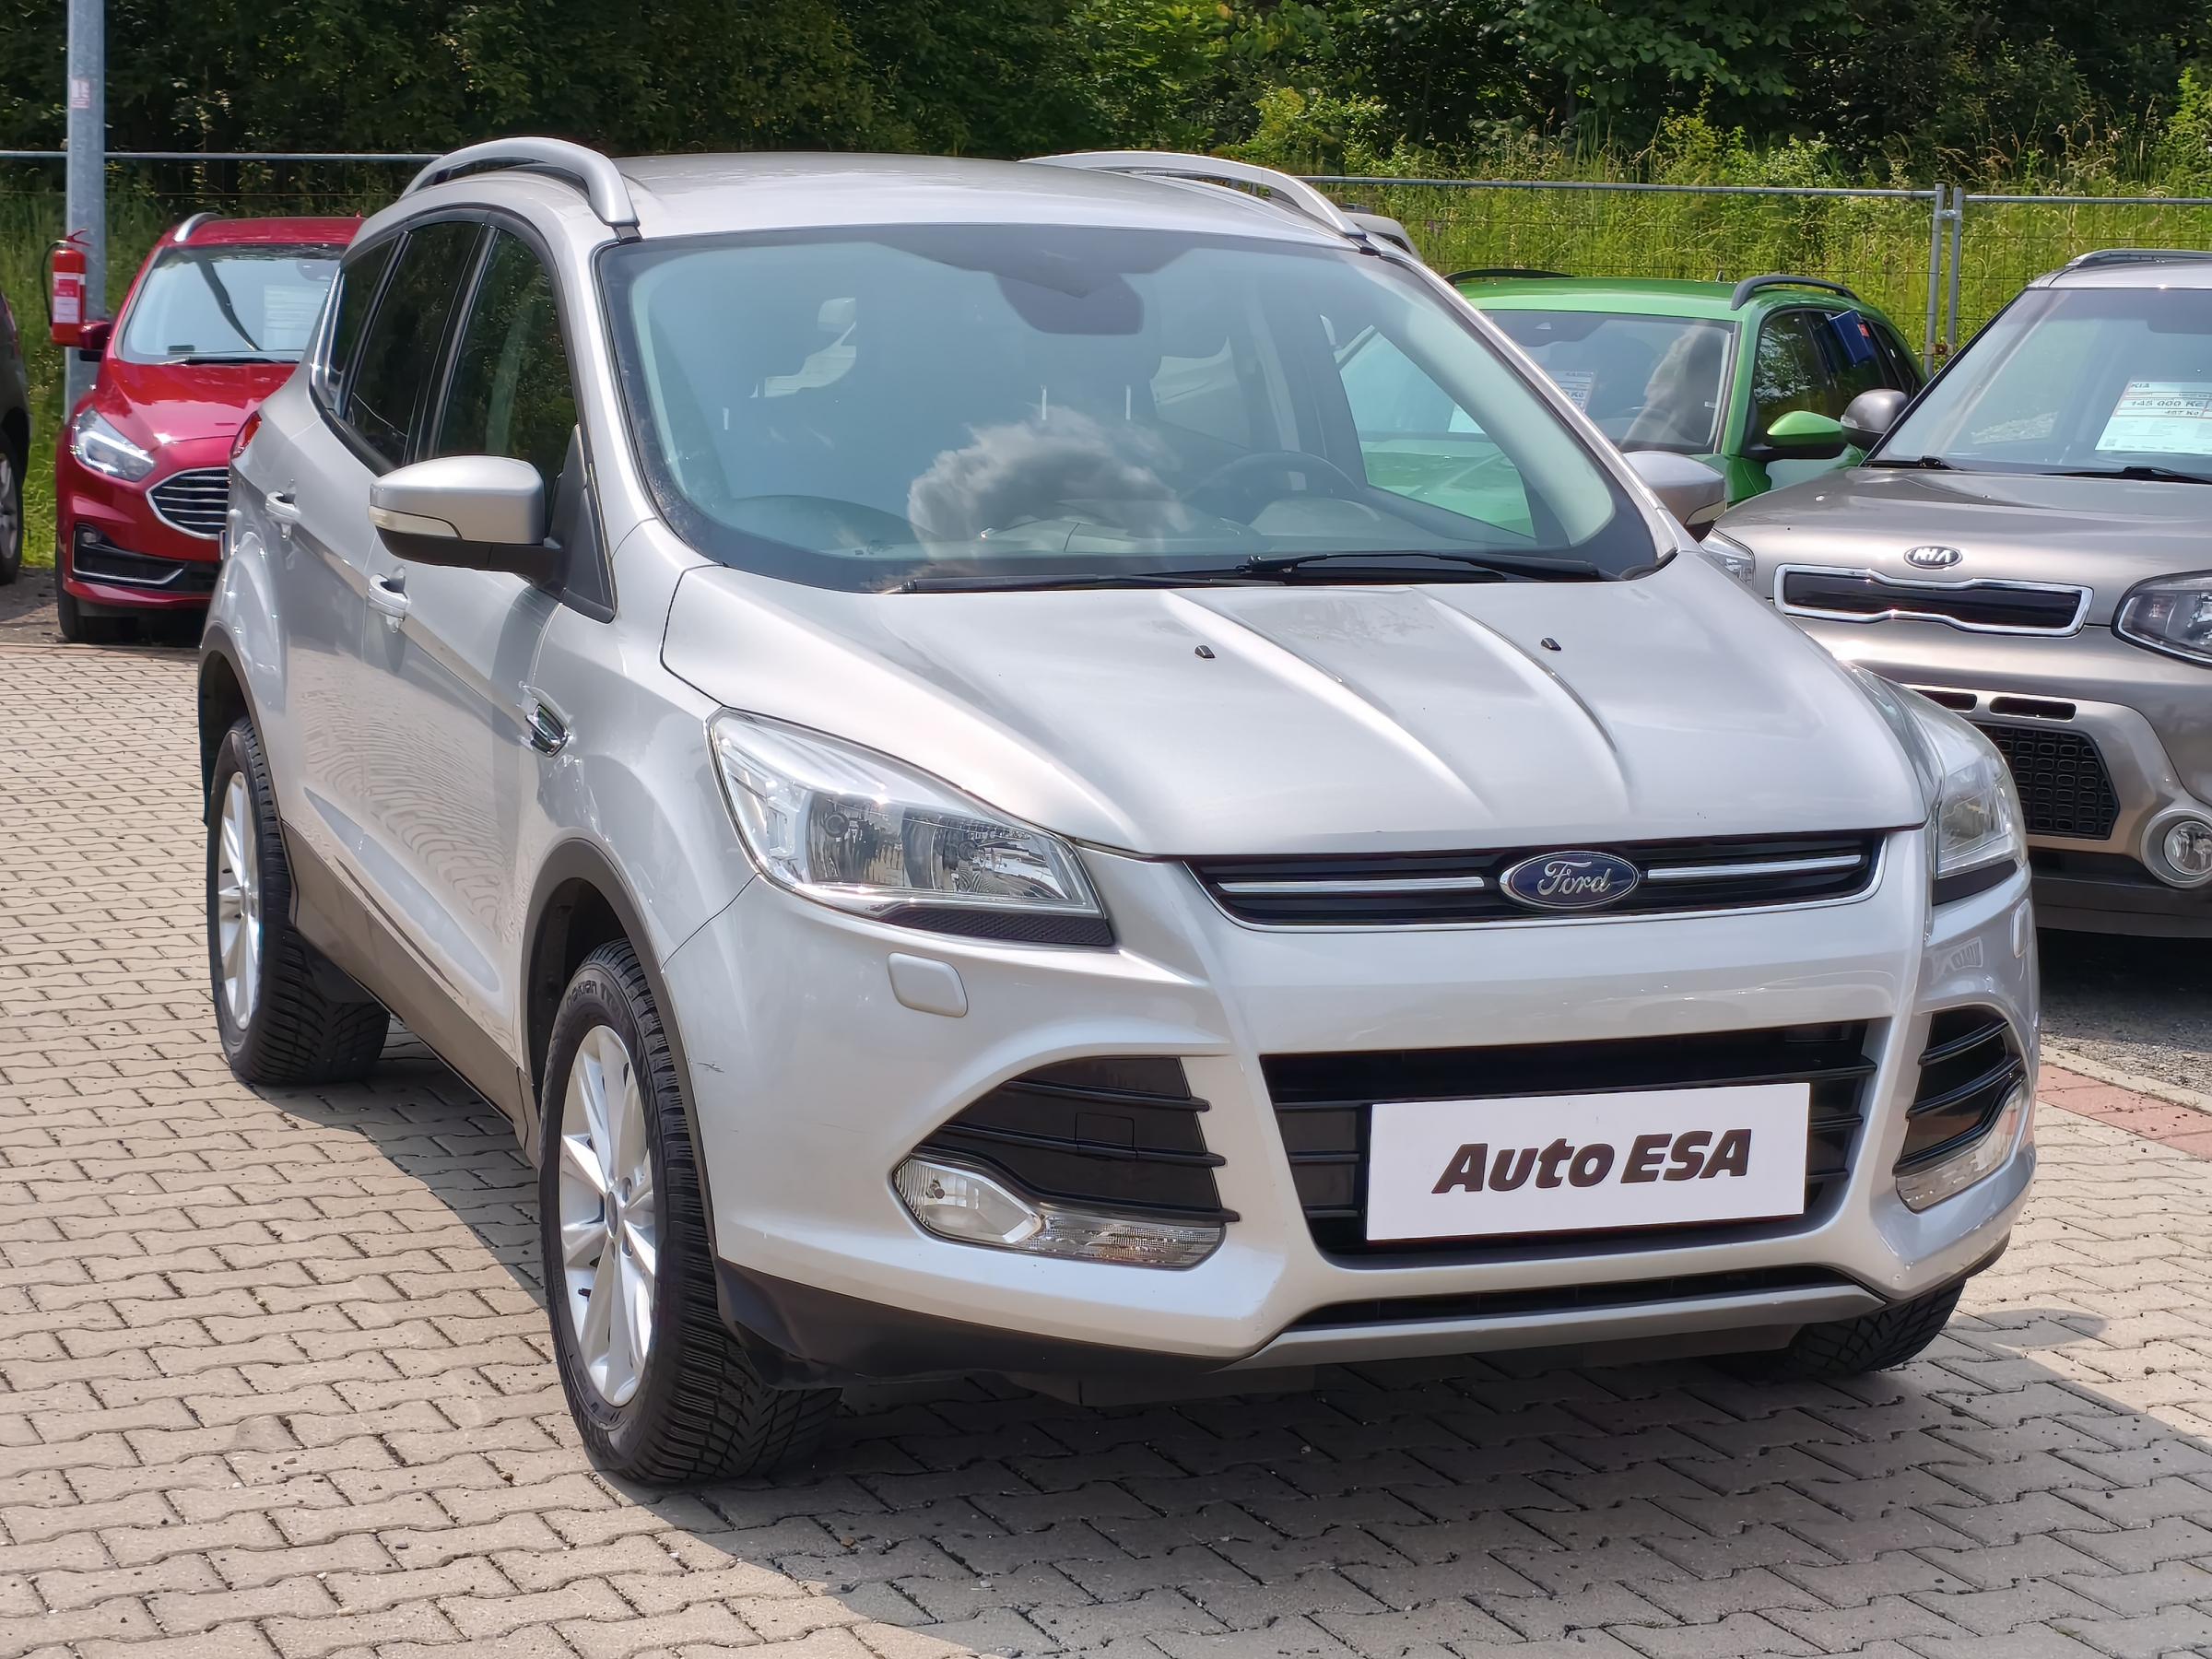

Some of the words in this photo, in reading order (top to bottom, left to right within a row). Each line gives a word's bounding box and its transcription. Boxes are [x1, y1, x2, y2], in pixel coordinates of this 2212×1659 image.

[2157, 399, 2182, 407] 000
[1912, 547, 1952, 563] KIA
[1536, 860, 1612, 896] Ford
[1430, 1137, 1615, 1194] Auto
[1620, 1128, 1751, 1184] ESA
